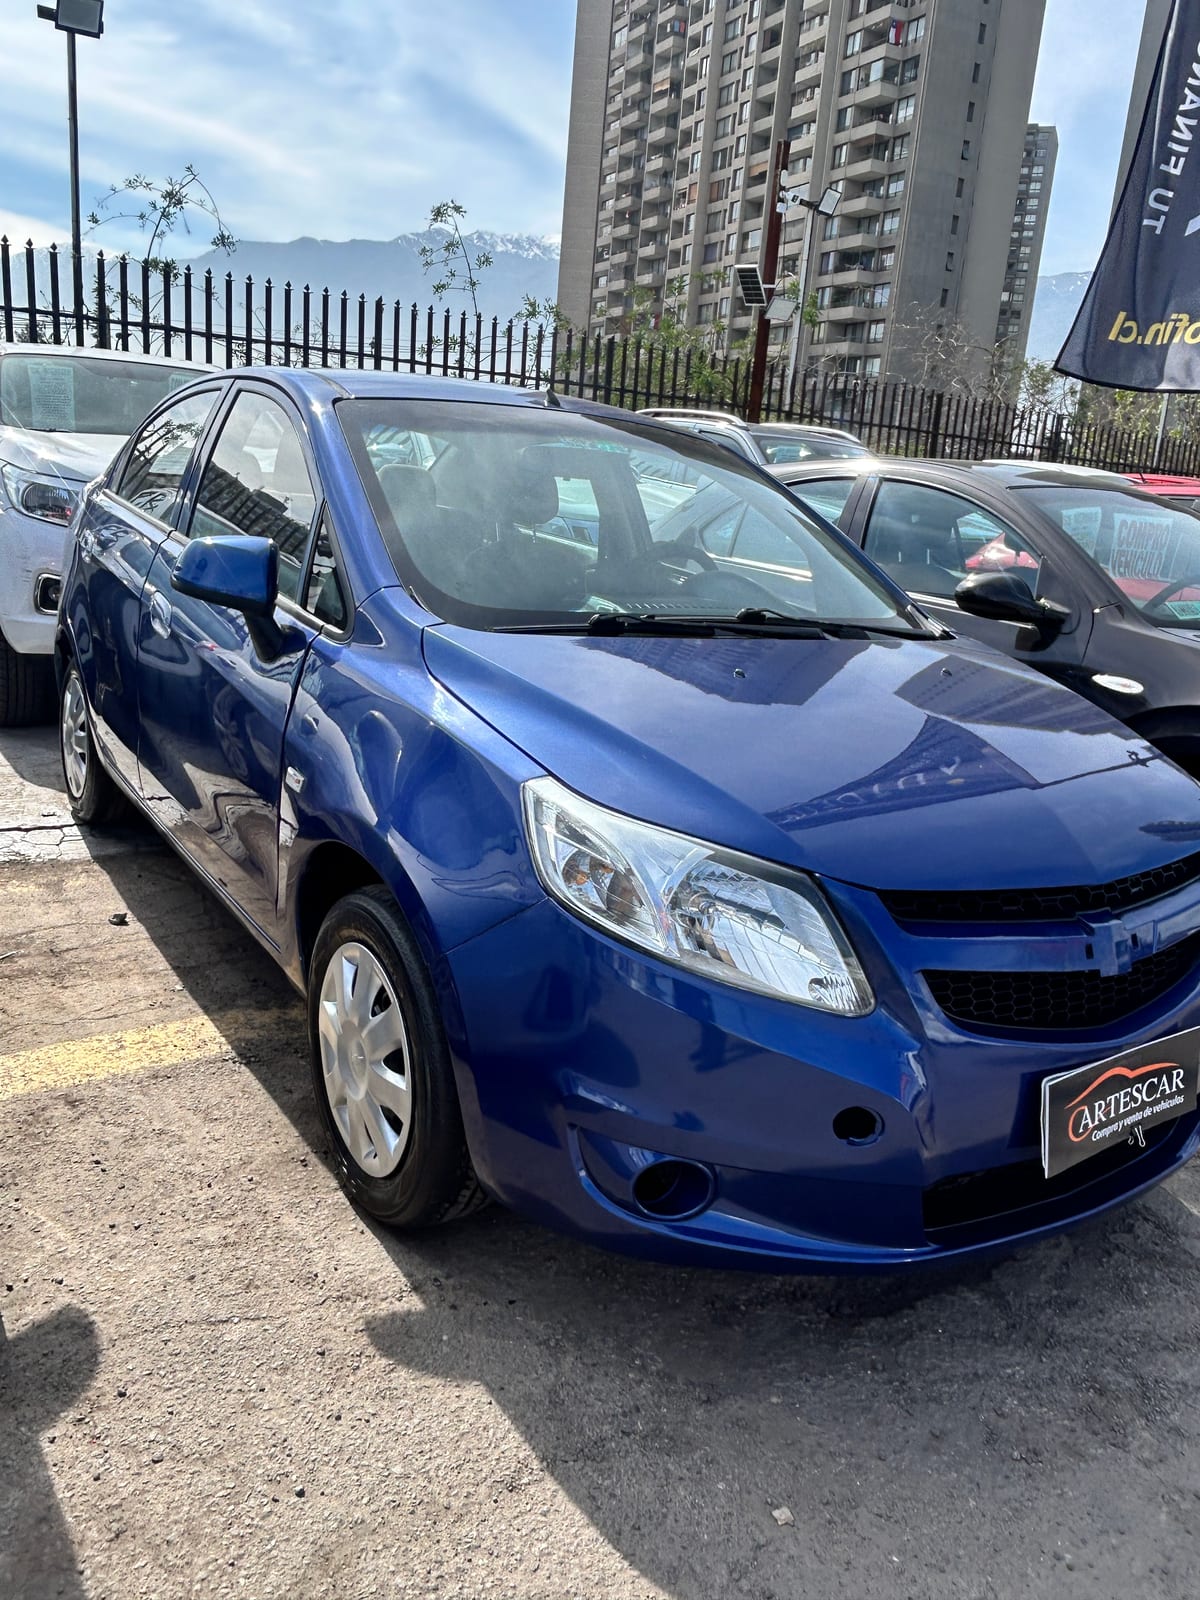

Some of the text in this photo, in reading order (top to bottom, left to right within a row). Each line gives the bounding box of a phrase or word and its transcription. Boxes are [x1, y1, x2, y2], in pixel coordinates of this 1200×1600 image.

[1117, 519, 1170, 551] COMPRO
[1110, 548, 1164, 579] VEHICULO
[1091, 1121, 1119, 1141] Compra
[1124, 1110, 1143, 1126] venta
[1143, 1105, 1153, 1118] de
